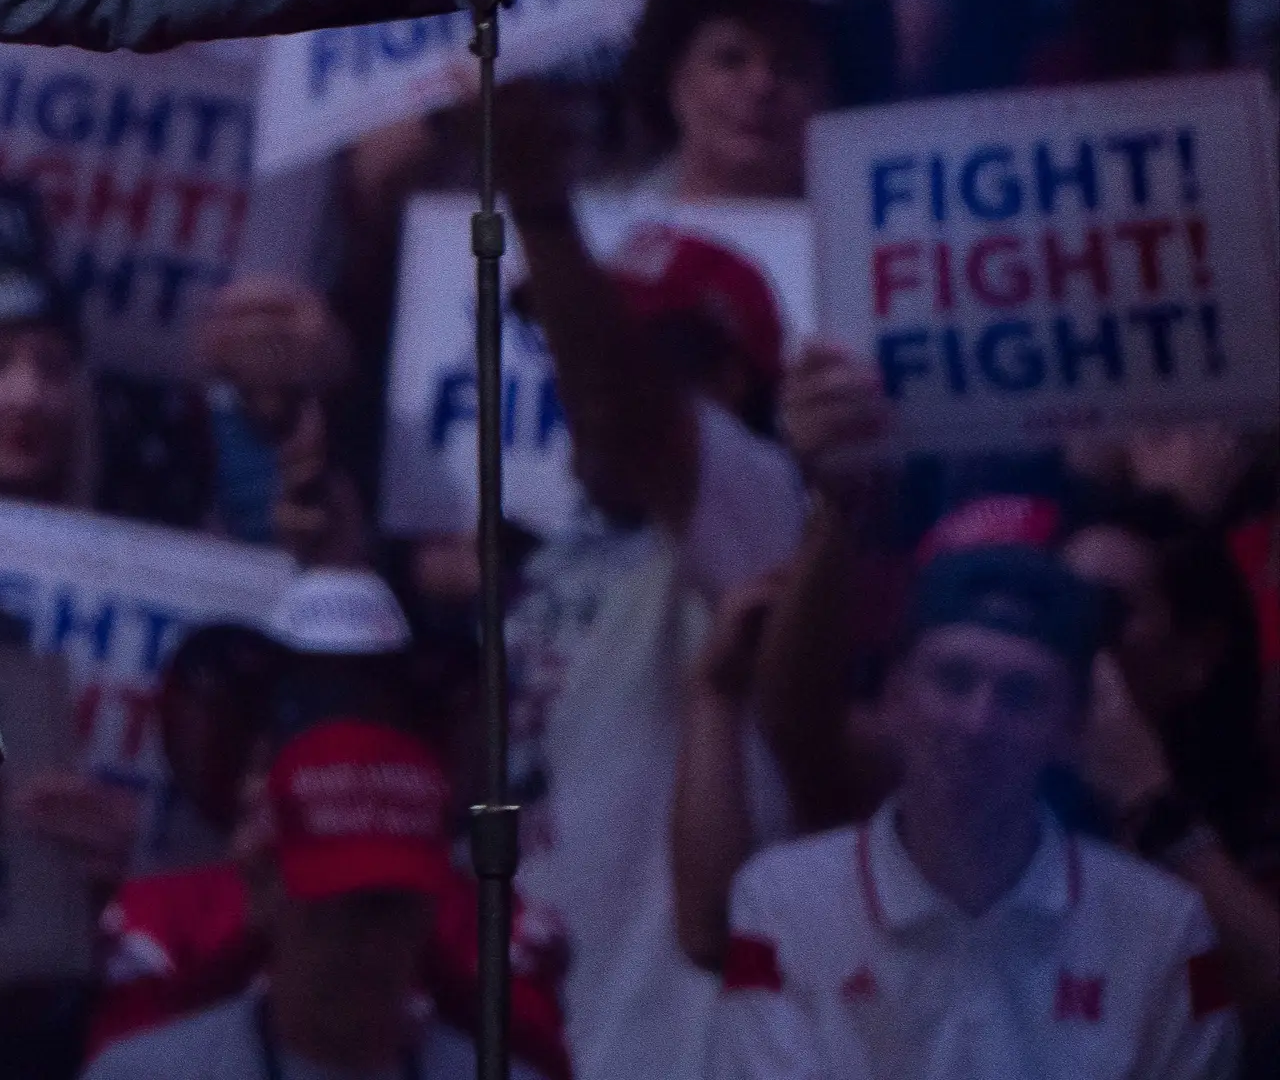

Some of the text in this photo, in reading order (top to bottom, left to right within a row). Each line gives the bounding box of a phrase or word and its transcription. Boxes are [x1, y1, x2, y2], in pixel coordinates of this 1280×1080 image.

[872, 128, 1202, 232] FIGHT!
[872, 216, 1214, 318] FIGHT!
[878, 302, 1226, 402] FIGHT!
